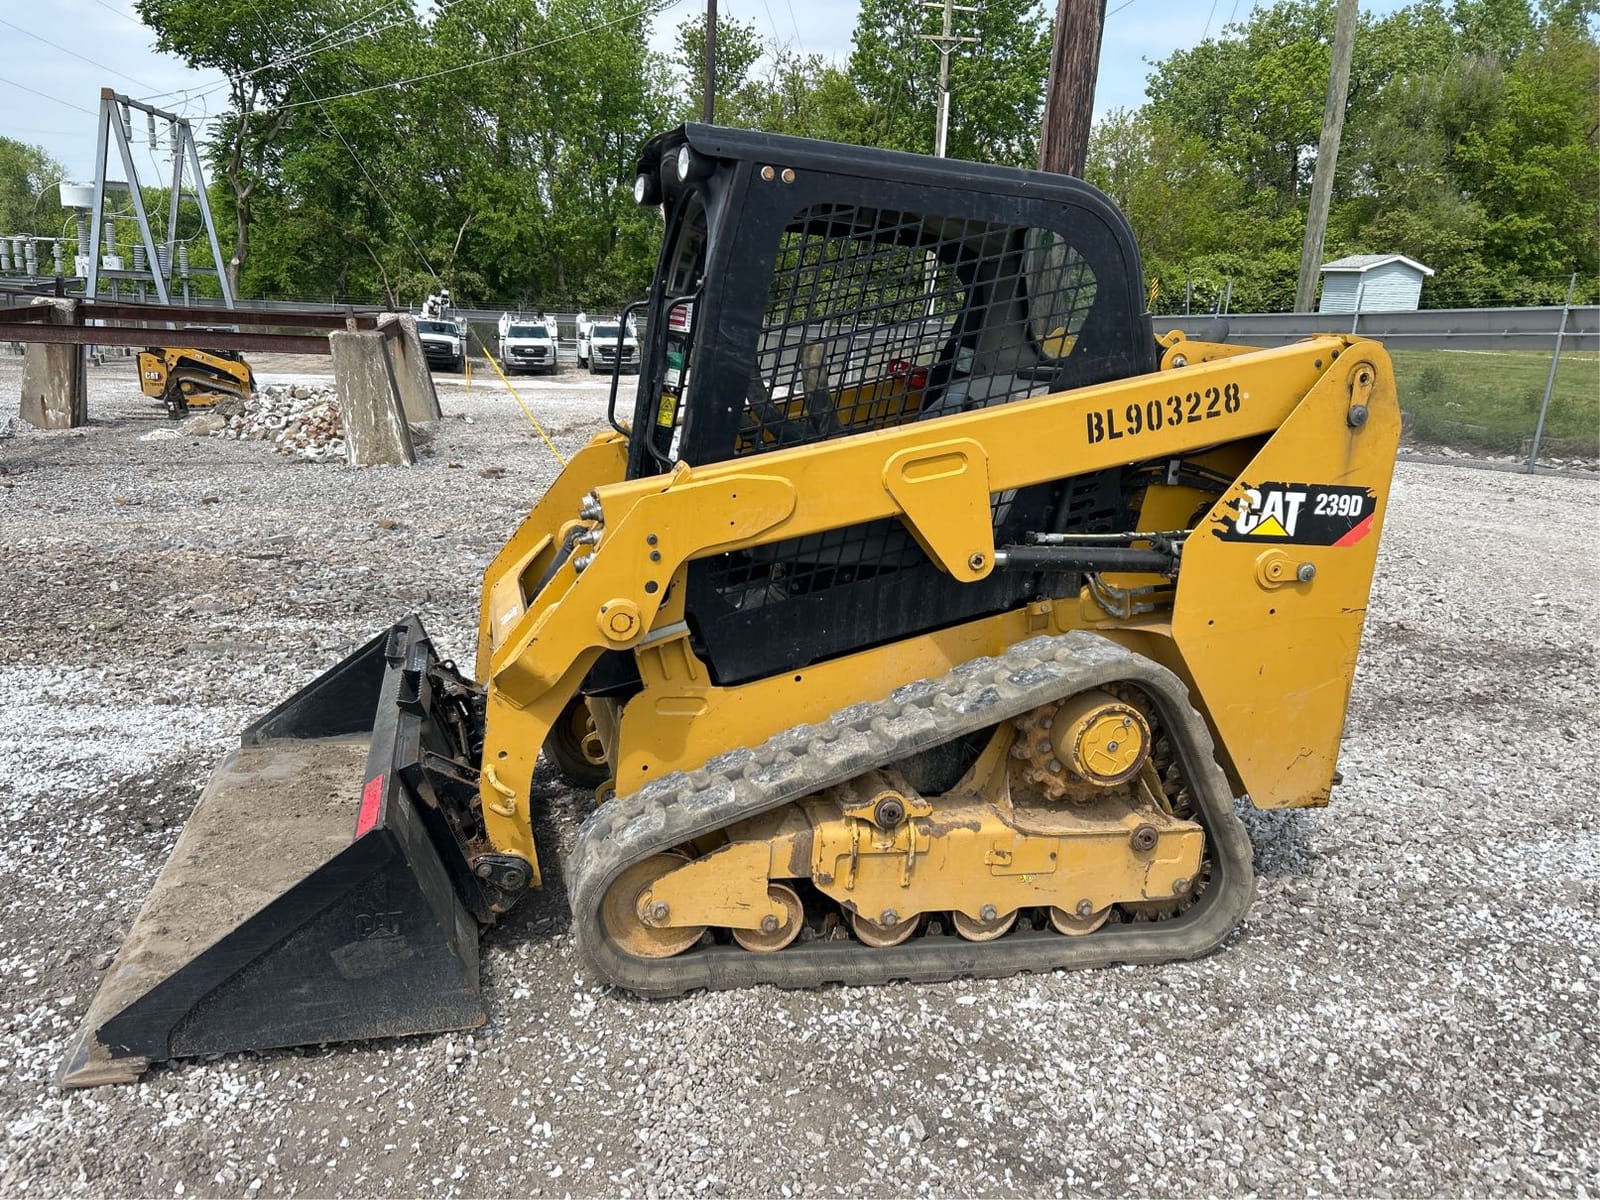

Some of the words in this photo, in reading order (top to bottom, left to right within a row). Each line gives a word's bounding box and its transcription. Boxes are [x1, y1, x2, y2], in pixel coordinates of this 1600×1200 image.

[145, 371, 160, 380] CAT
[1086, 383, 1241, 444] BL903228
[1236, 489, 1306, 537] CAT
[1314, 493, 1363, 517] 239D
